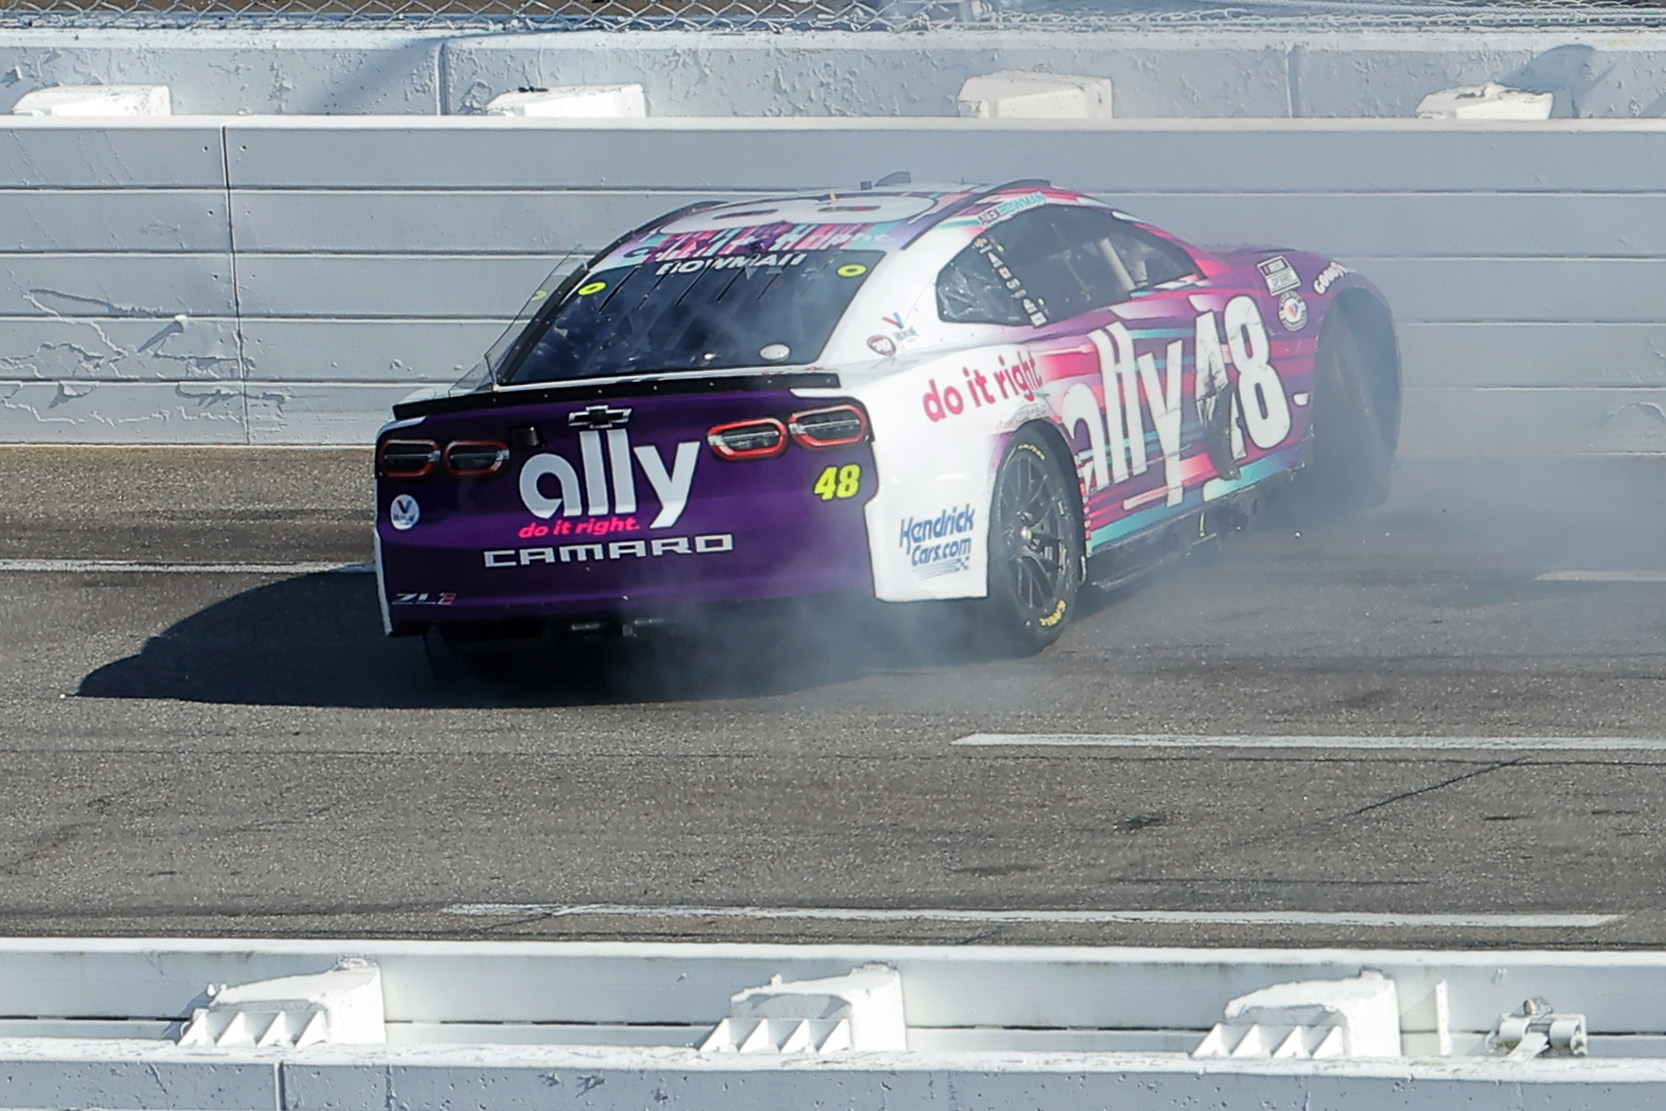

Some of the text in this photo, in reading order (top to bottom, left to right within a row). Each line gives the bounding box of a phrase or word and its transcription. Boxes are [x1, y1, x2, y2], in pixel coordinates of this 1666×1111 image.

[922, 350, 1043, 423] do it right
[1062, 320, 1184, 508] ally
[519, 428, 701, 529] ally
[813, 463, 862, 501] 48
[484, 533, 734, 568] CAMARO
[518, 522, 549, 538] do
[552, 519, 572, 535] it
[899, 502, 976, 556] Hendrick
[911, 537, 972, 567] Cars.com
